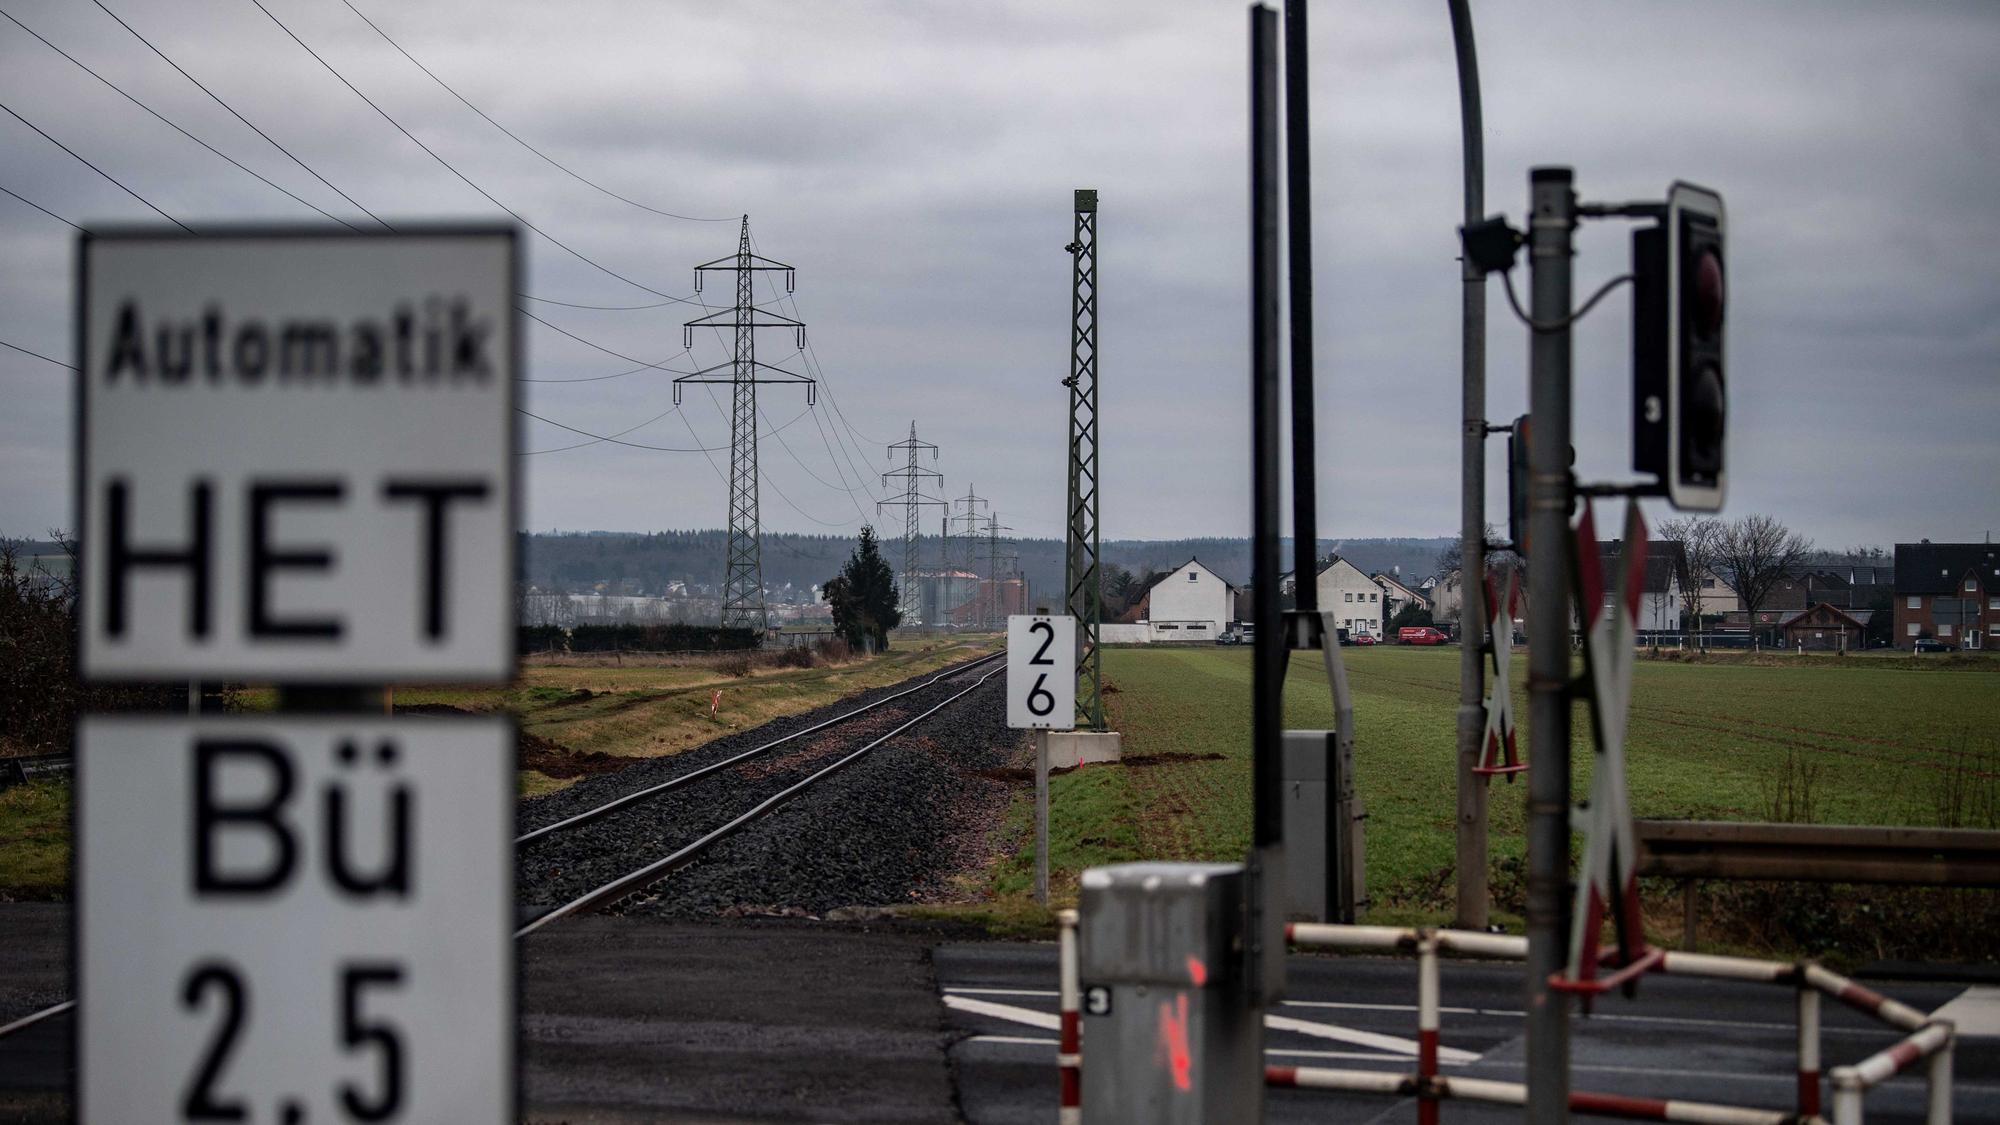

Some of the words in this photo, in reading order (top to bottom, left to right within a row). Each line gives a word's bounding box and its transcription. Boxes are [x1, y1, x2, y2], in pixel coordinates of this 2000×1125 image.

[104, 294, 493, 386] Automatik
[102, 474, 493, 644] HET
[1029, 622, 1054, 665] 2
[1027, 673, 1055, 716] 6
[190, 734, 413, 901] Bü
[1088, 987, 1108, 1014] 3
